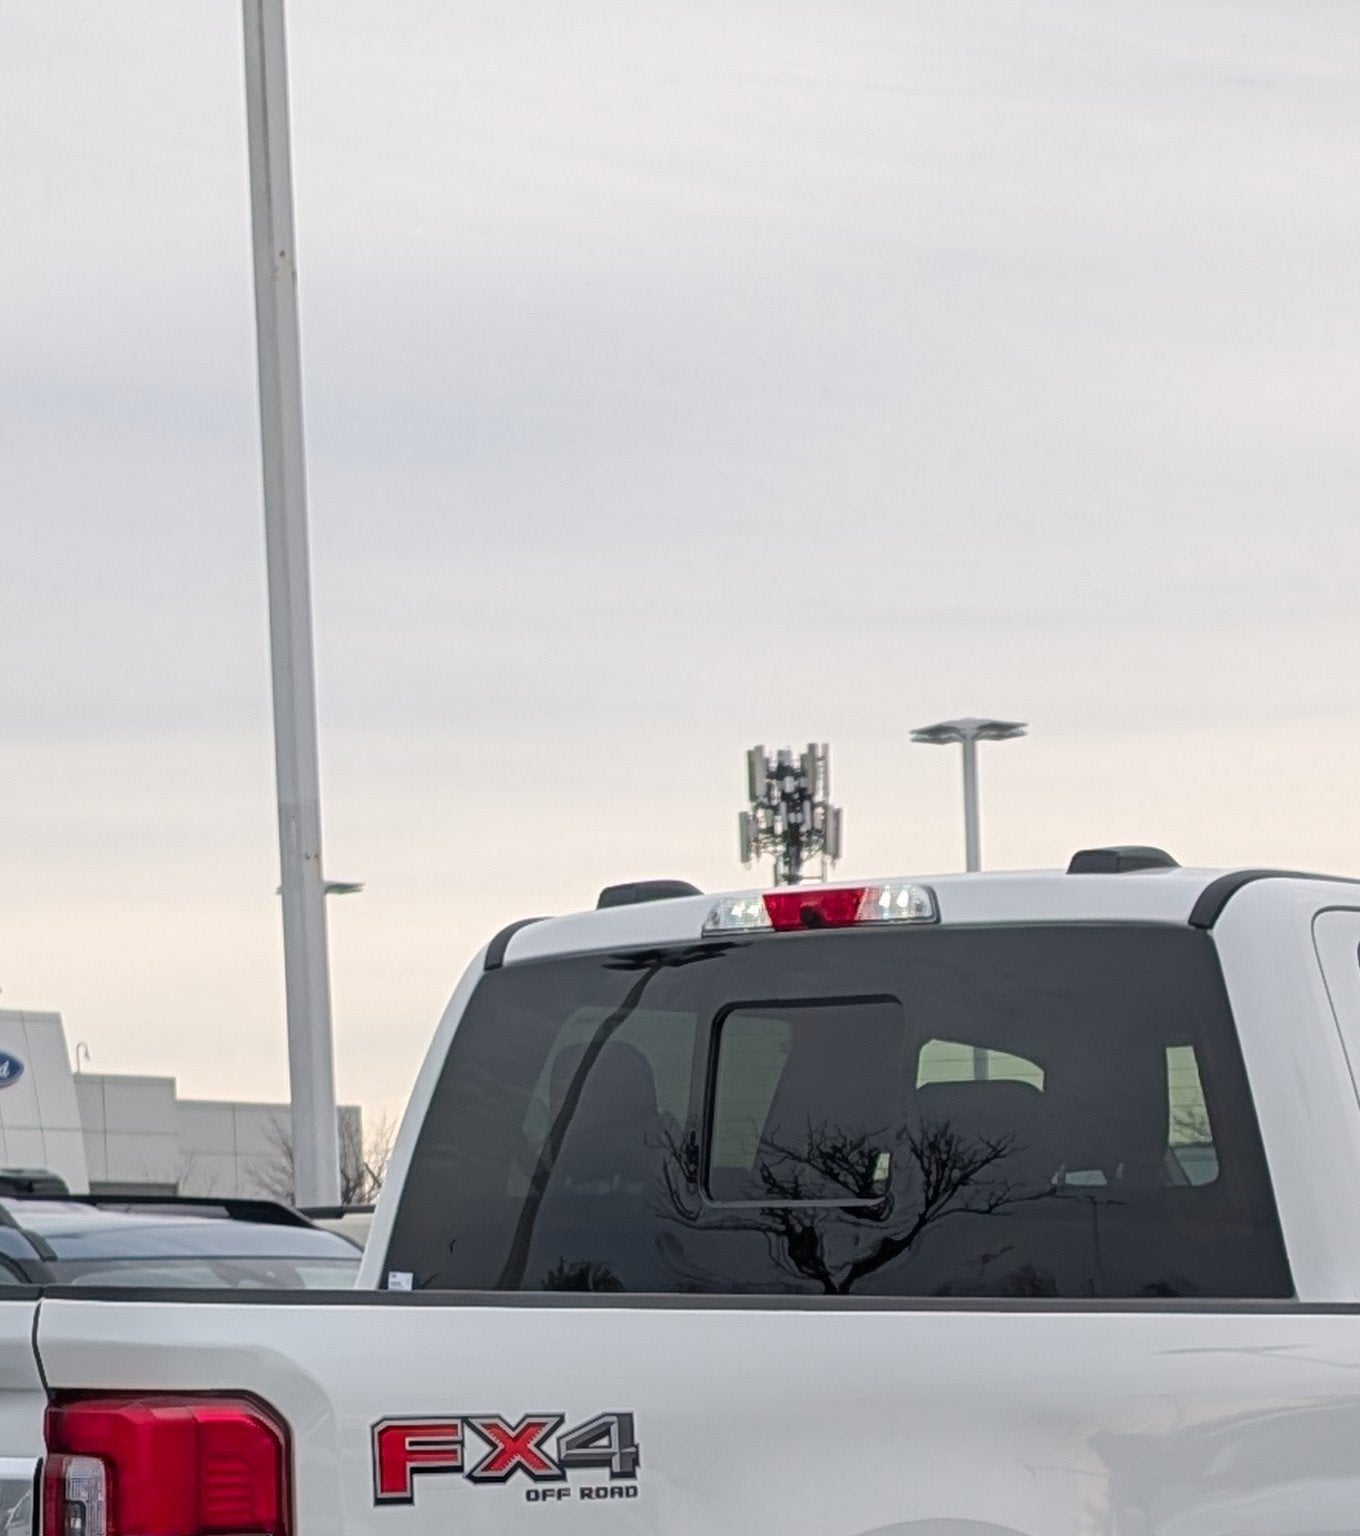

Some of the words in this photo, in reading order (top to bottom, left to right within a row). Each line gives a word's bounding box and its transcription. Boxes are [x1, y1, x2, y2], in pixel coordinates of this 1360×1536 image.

[370, 1411, 641, 1507] FX4
[525, 1487, 571, 1502] OFF
[579, 1485, 639, 1501] ROAD
